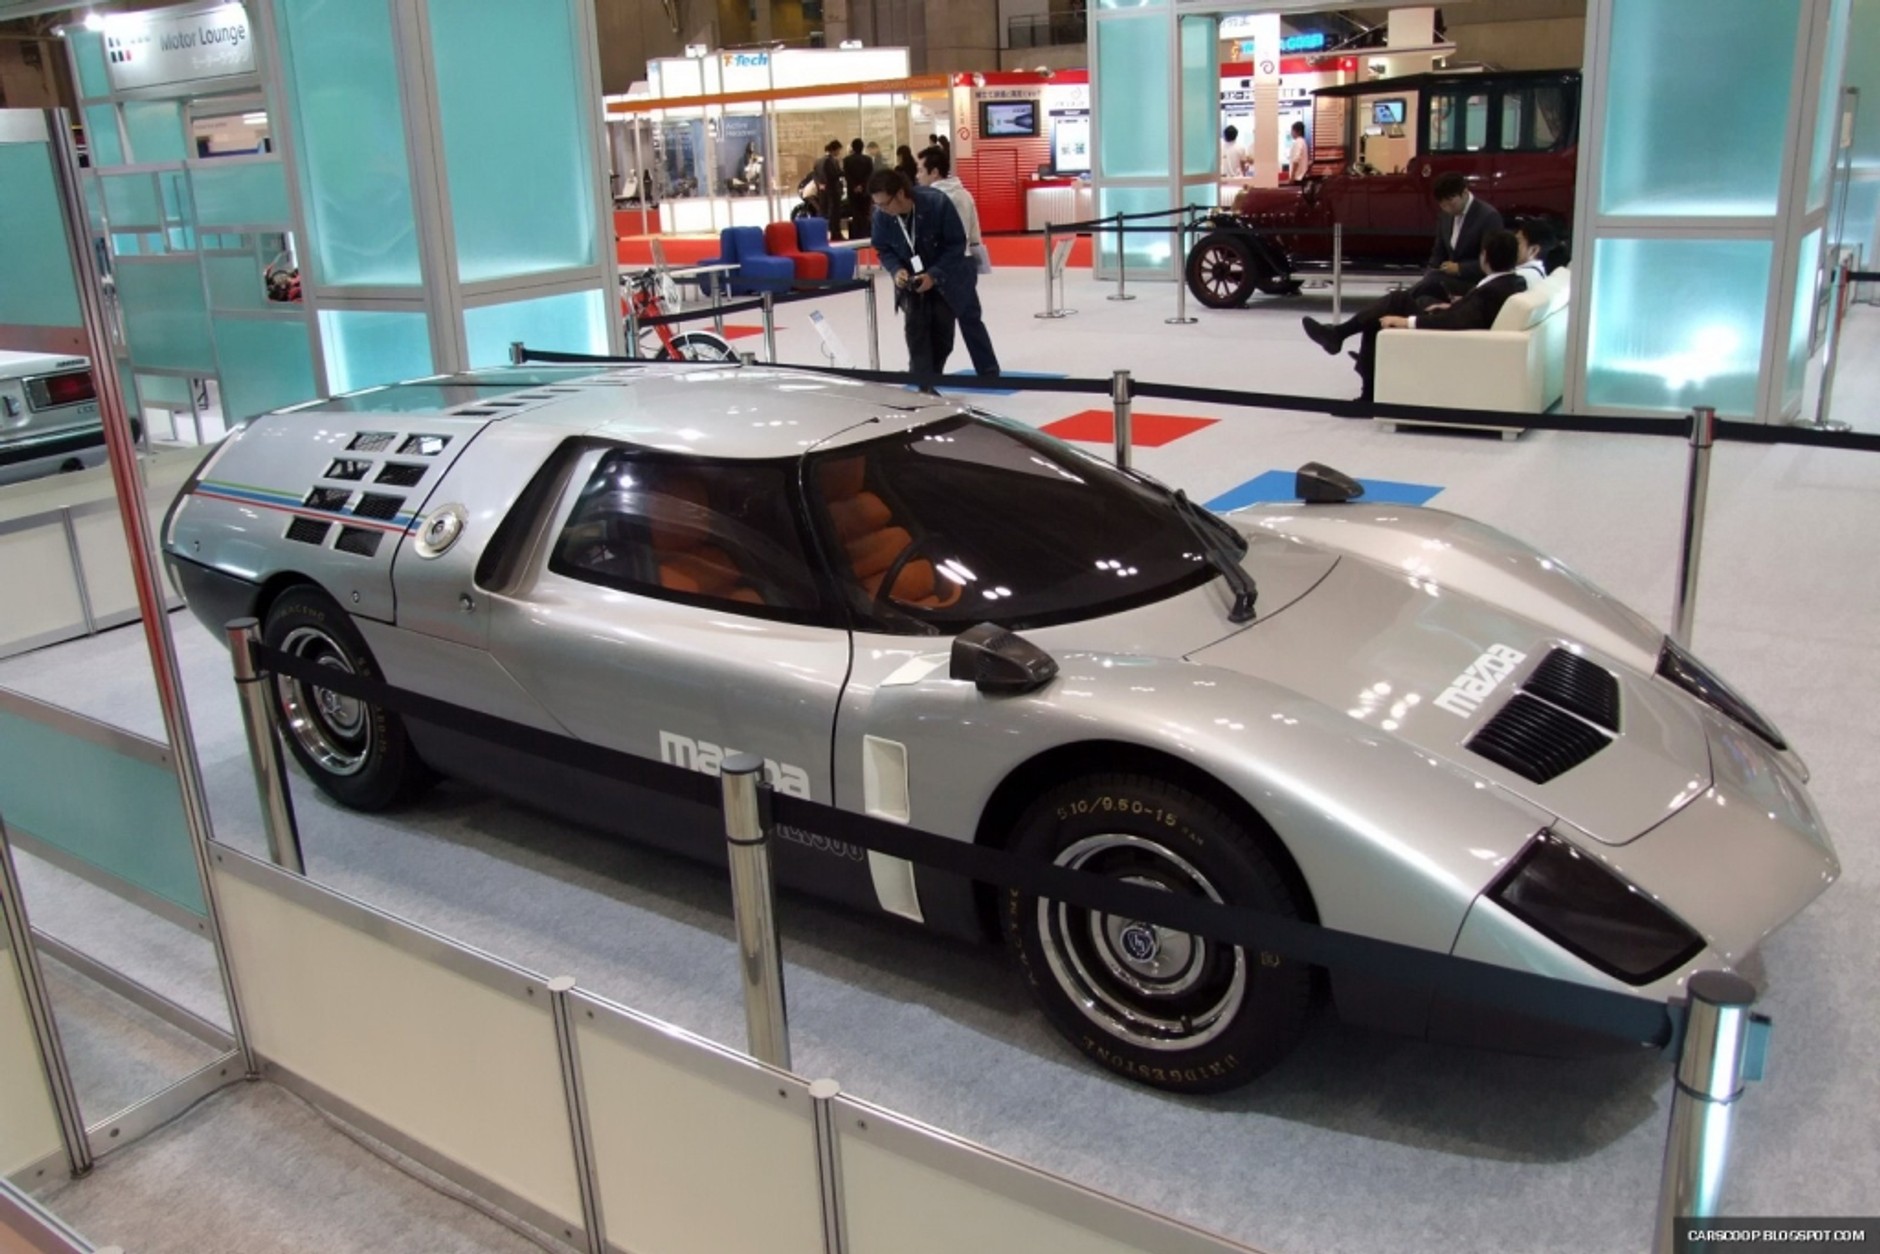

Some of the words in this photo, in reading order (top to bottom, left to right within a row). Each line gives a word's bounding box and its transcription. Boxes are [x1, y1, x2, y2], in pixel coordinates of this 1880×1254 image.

[160, 33, 197, 51] Motor
[199, 24, 246, 46] Lounge
[1432, 642, 1528, 720] mazda
[659, 729, 811, 801] mada
